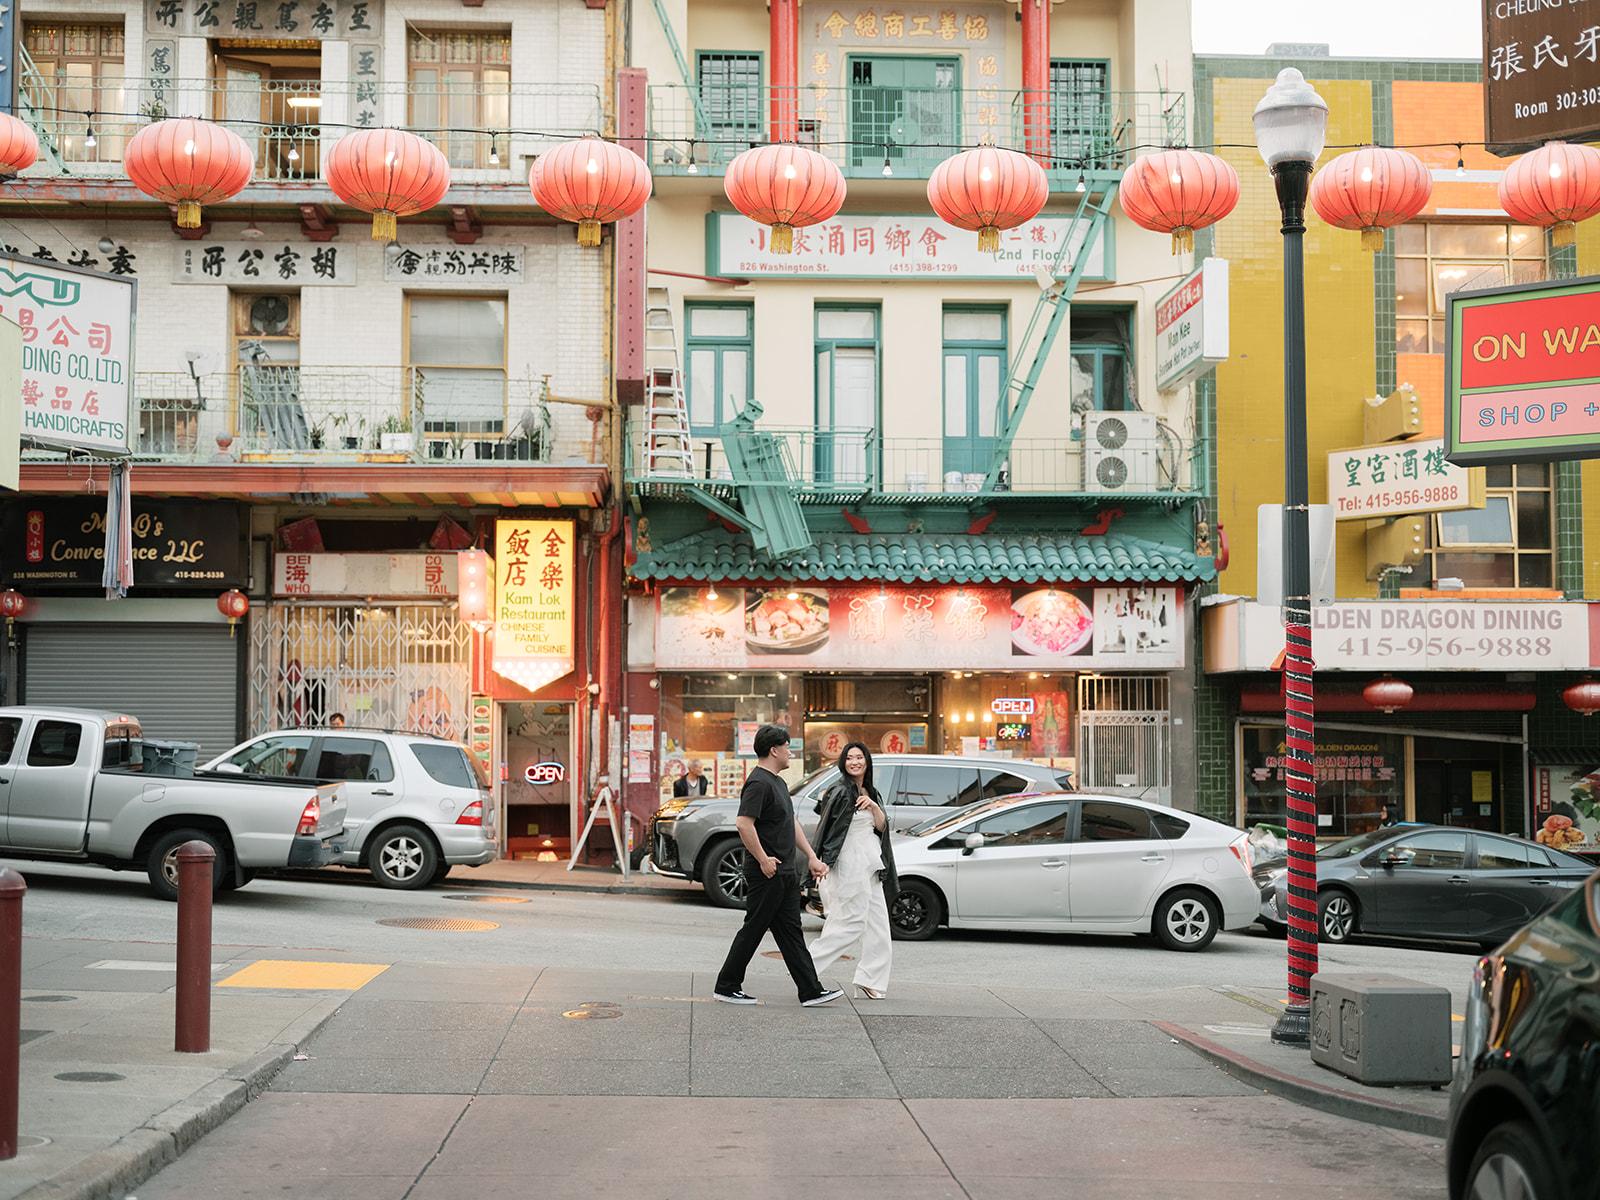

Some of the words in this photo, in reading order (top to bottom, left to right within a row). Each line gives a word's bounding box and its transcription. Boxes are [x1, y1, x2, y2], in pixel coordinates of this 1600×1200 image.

[1515, 101, 1548, 119] Room
[740, 262, 757, 272] 826
[759, 262, 815, 274] Washington
[816, 262, 830, 272] St.
[889, 263, 913, 273] (415)
[915, 263, 958, 273] 398-1299
[1473, 331, 1527, 362] ON
[1478, 401, 1568, 427] SHOP
[25, 410, 124, 440] HANDICRAFTS
[1338, 495, 1362, 512] Tel:
[1366, 485, 1459, 509] 415-956-9888
[162, 539, 204, 563] LLC
[505, 592, 533, 605] Kam
[539, 592, 560, 605] Lok
[501, 607, 566, 621] Restaurant
[1381, 608, 1475, 630] DRAGON
[1484, 609, 1562, 630] DINING
[501, 622, 545, 632] CHINESE
[514, 634, 550, 643] FAMILY
[525, 645, 568, 654] CUISINE
[1338, 636, 1552, 657] 415-956-9888
[991, 701, 1031, 712] OPEN
[525, 766, 565, 781] OPEN
